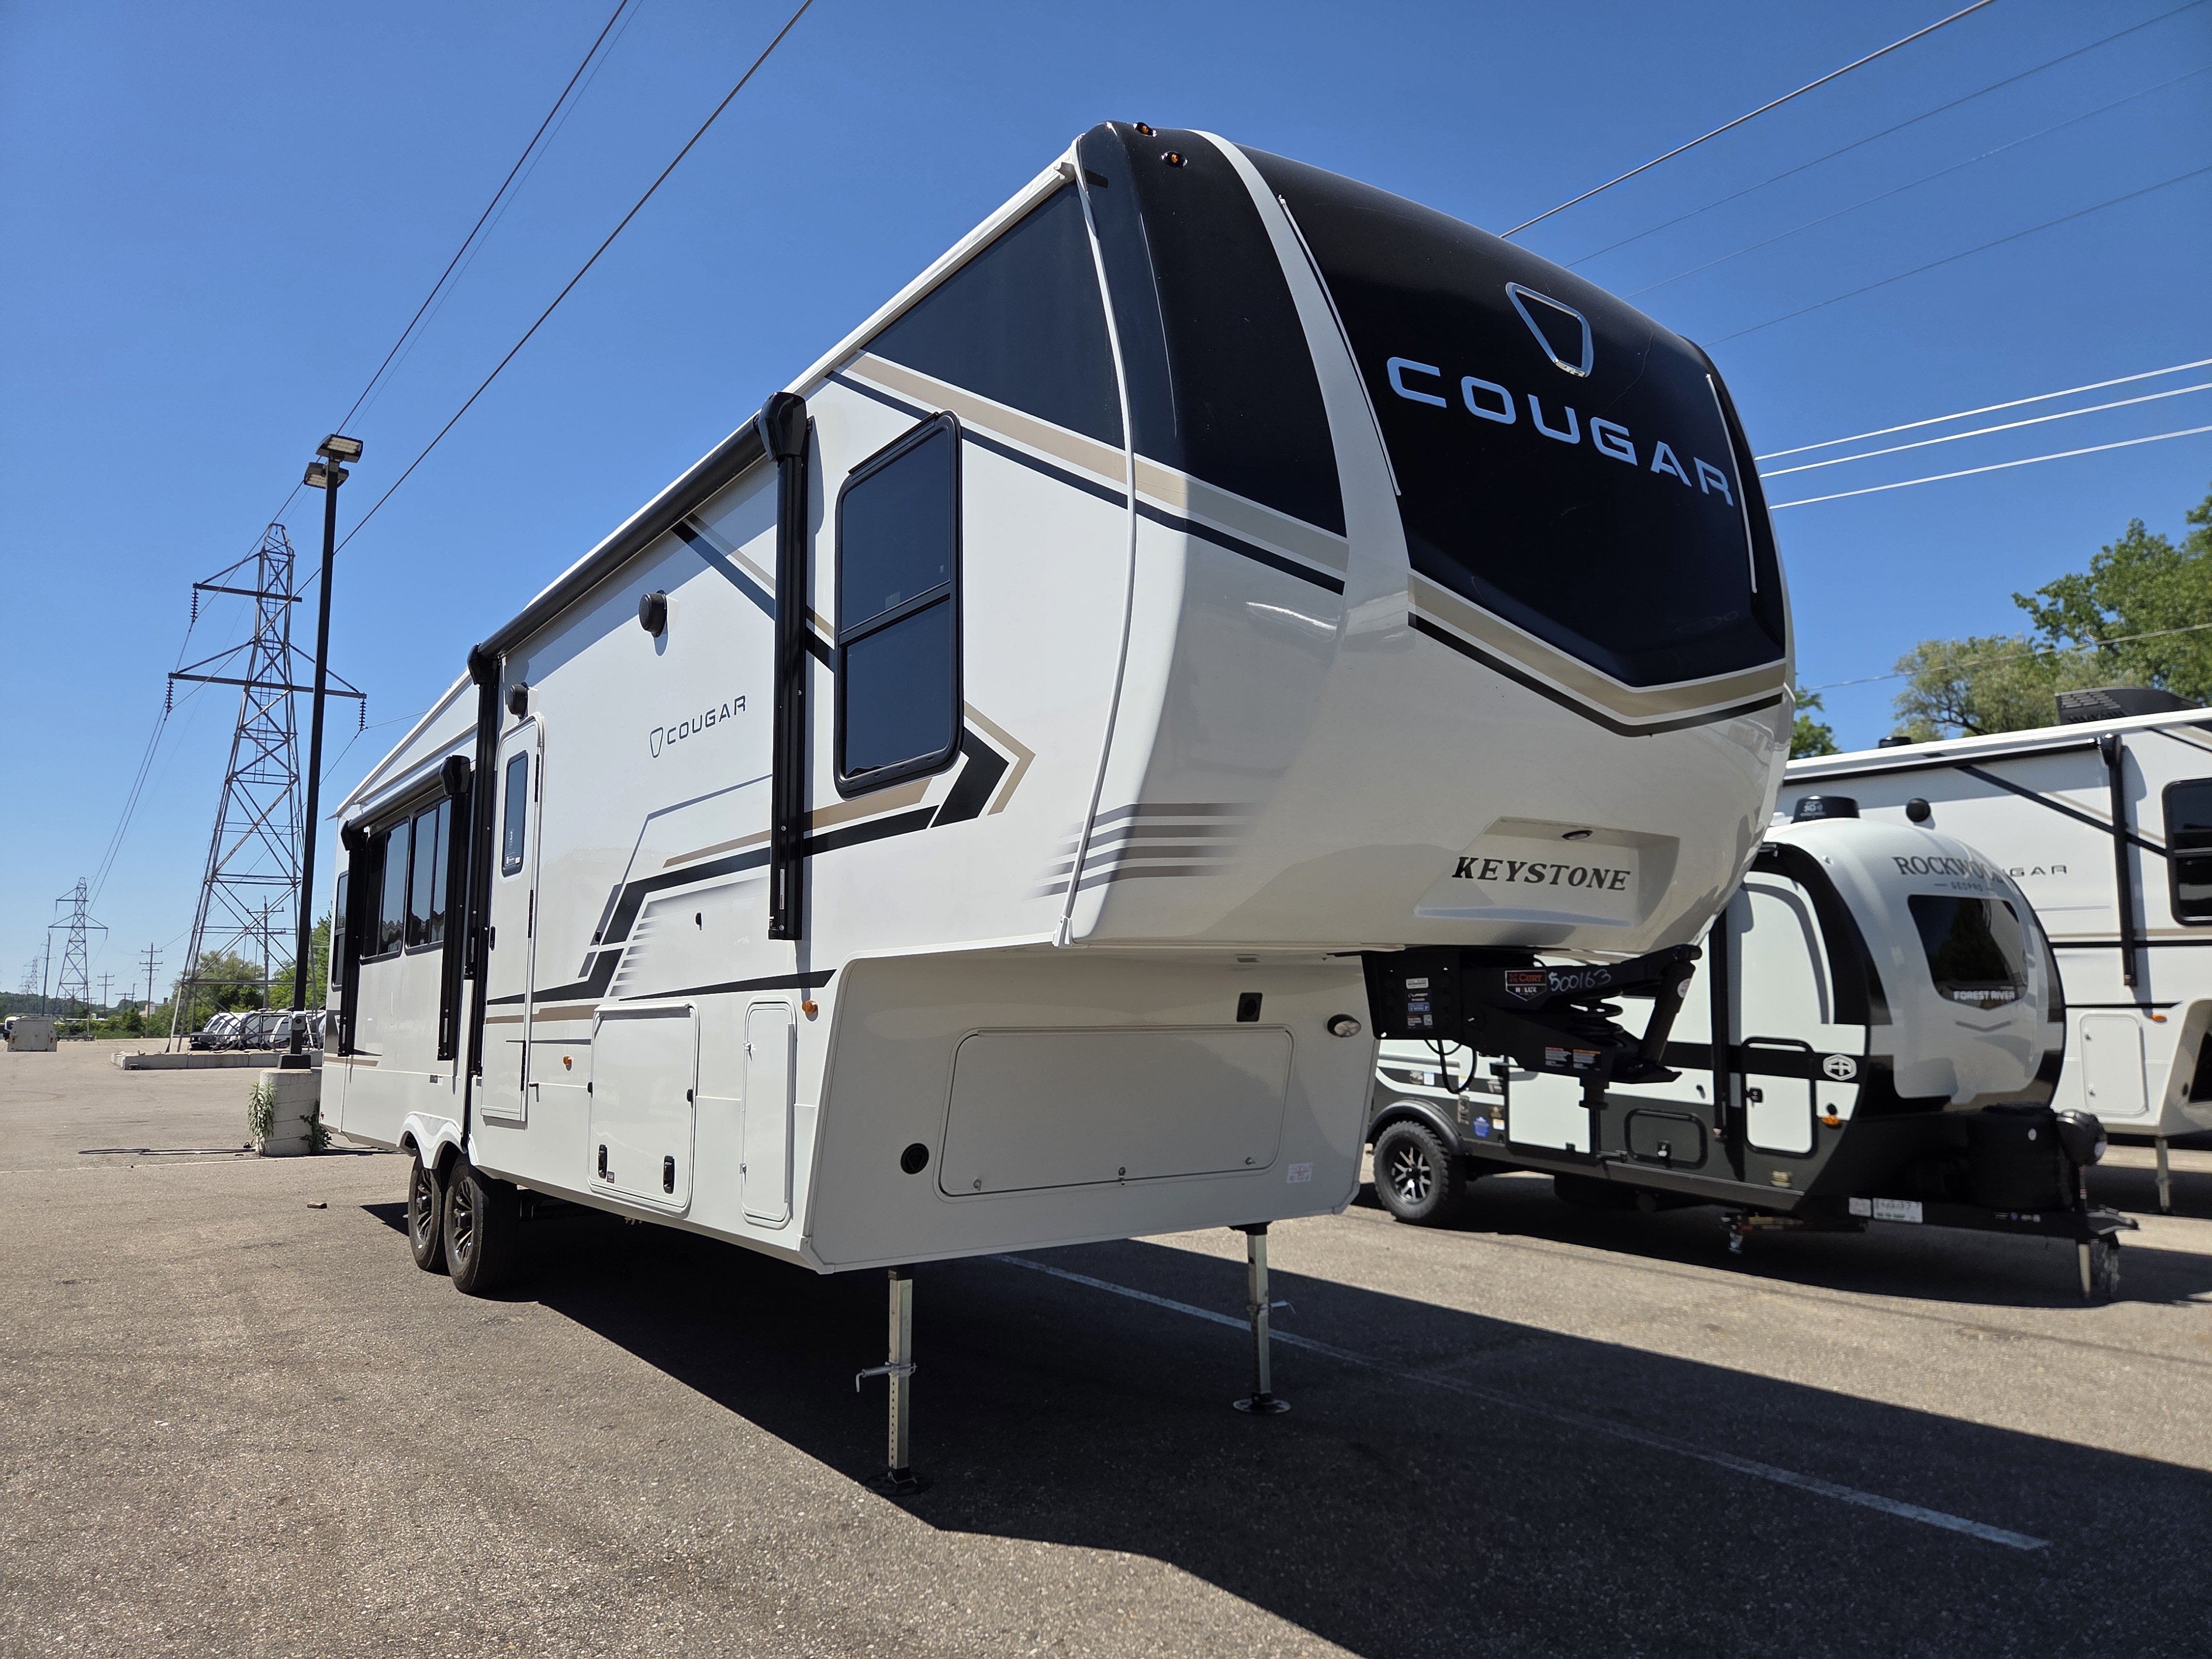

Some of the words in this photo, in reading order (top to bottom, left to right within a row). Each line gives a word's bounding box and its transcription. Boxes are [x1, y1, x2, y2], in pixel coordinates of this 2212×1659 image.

[1386, 357, 1734, 507] COUGAR
[667, 695, 746, 745] COUGAR
[1452, 857, 1631, 891] KEYSTONE
[2009, 864, 2067, 878] GAR
[1548, 969, 1611, 992] 500163
[1953, 990, 1989, 1000] FOREST
[1991, 990, 2015, 1000] RIVER
